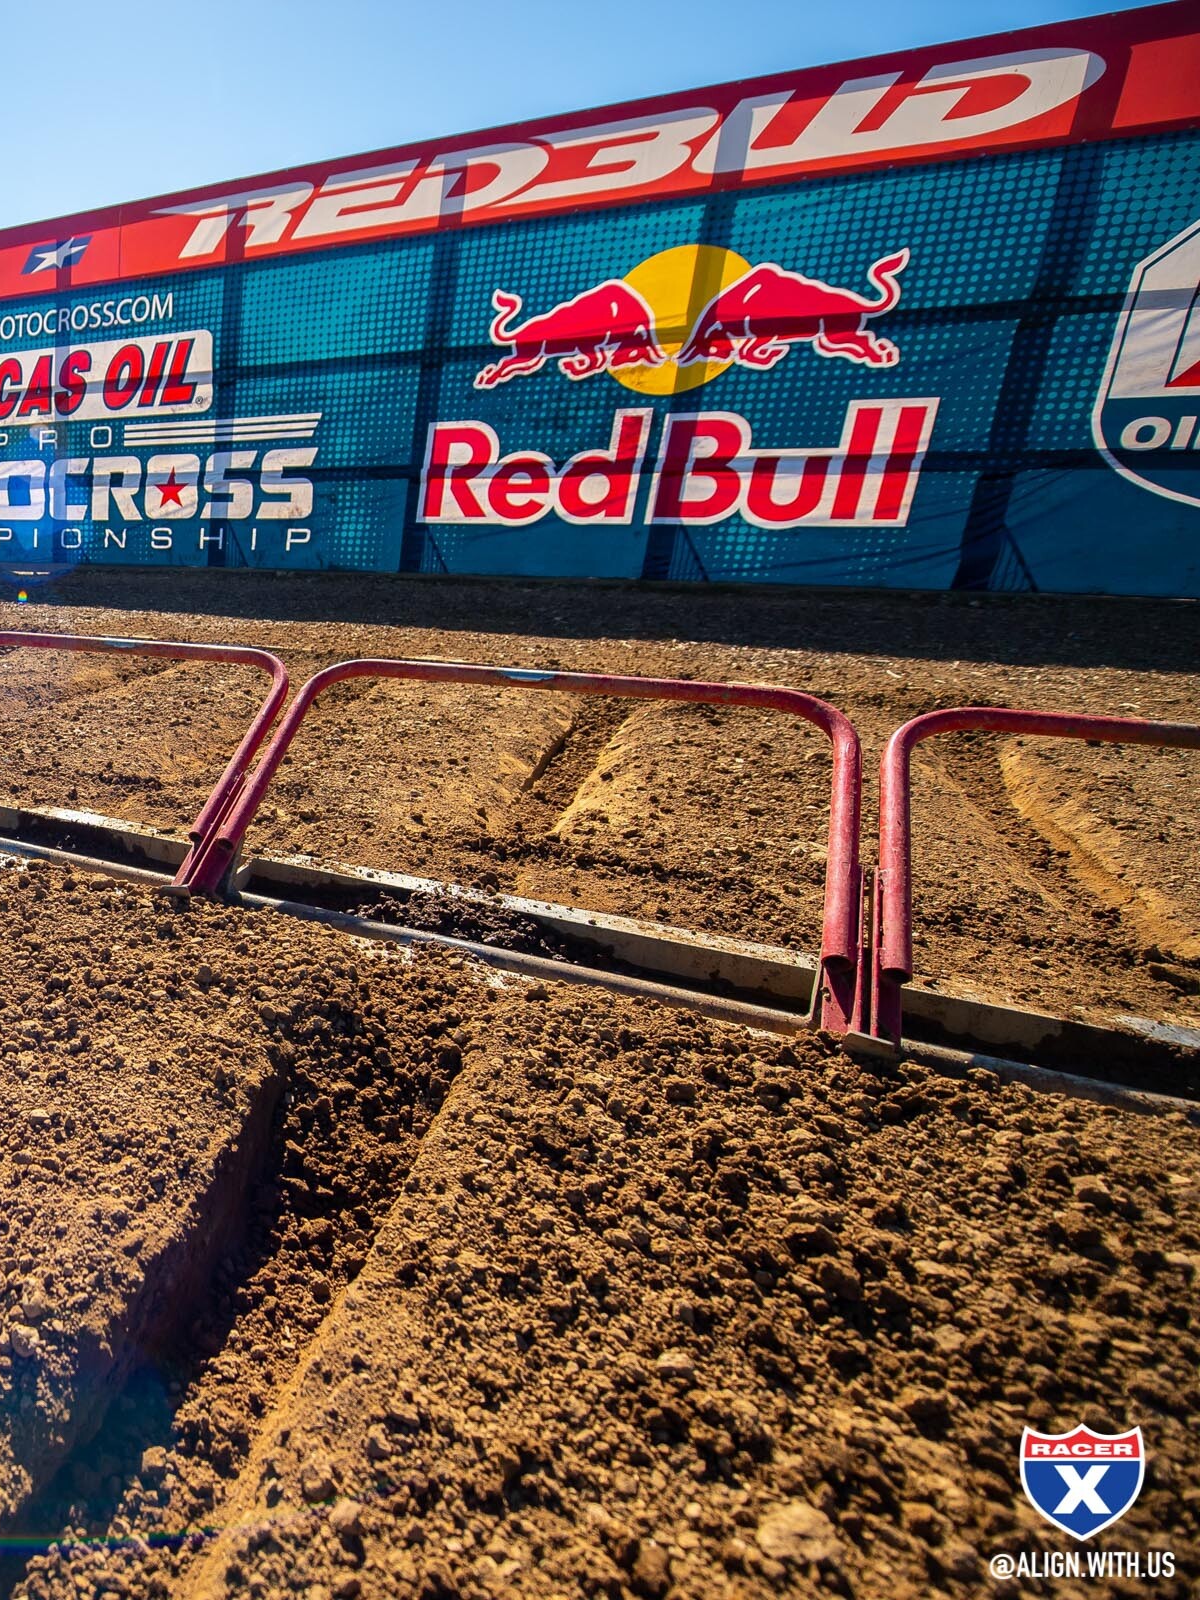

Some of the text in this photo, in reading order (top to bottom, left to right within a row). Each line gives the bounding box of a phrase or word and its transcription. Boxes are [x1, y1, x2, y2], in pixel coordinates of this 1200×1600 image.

[149, 47, 1107, 260] REDBUD
[102, 338, 198, 411] OIL
[416, 397, 940, 527] Red Bull
[1120, 414, 1200, 450] OI
